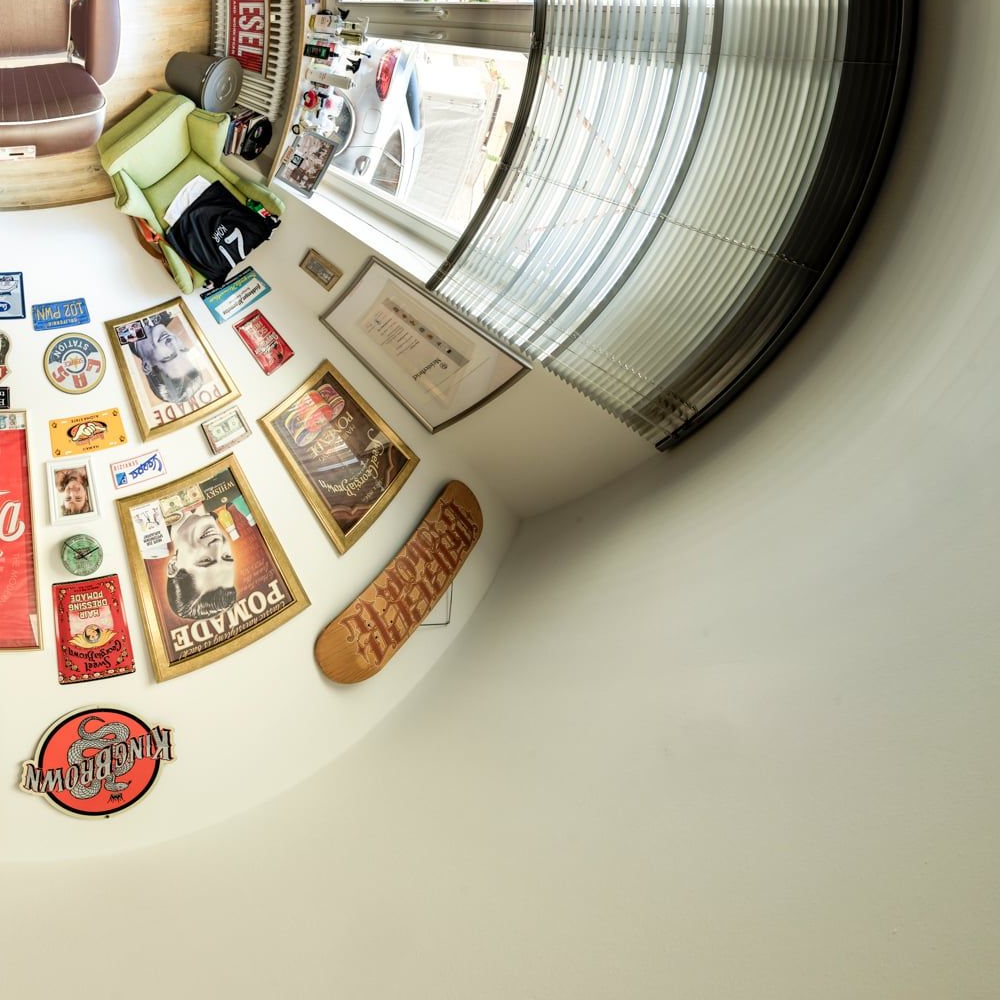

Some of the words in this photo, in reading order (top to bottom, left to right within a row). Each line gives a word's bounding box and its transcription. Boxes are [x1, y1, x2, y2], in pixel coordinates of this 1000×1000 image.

[209, 223, 229, 243] KOHR
[36, 307, 59, 319] PWN
[63, 302, 83, 316] 102
[53, 339, 88, 358] STATION
[411, 357, 442, 381] Meisterbrief
[152, 382, 221, 425] POMADE
[305, 411, 353, 459] POMADE
[366, 428, 382, 468] Sweet
[128, 453, 162, 479] Vespa
[346, 463, 379, 491] Georgia
[203, 480, 235, 502] WHISKY
[317, 480, 356, 498] Brown
[68, 598, 106, 609] DRESSING
[70, 590, 103, 601] POMADE
[78, 609, 99, 618] HAIR
[168, 578, 284, 653] POMADE
[211, 616, 258, 647] hairstyling
[175, 642, 203, 661] back!
[84, 655, 110, 672] Sweet
